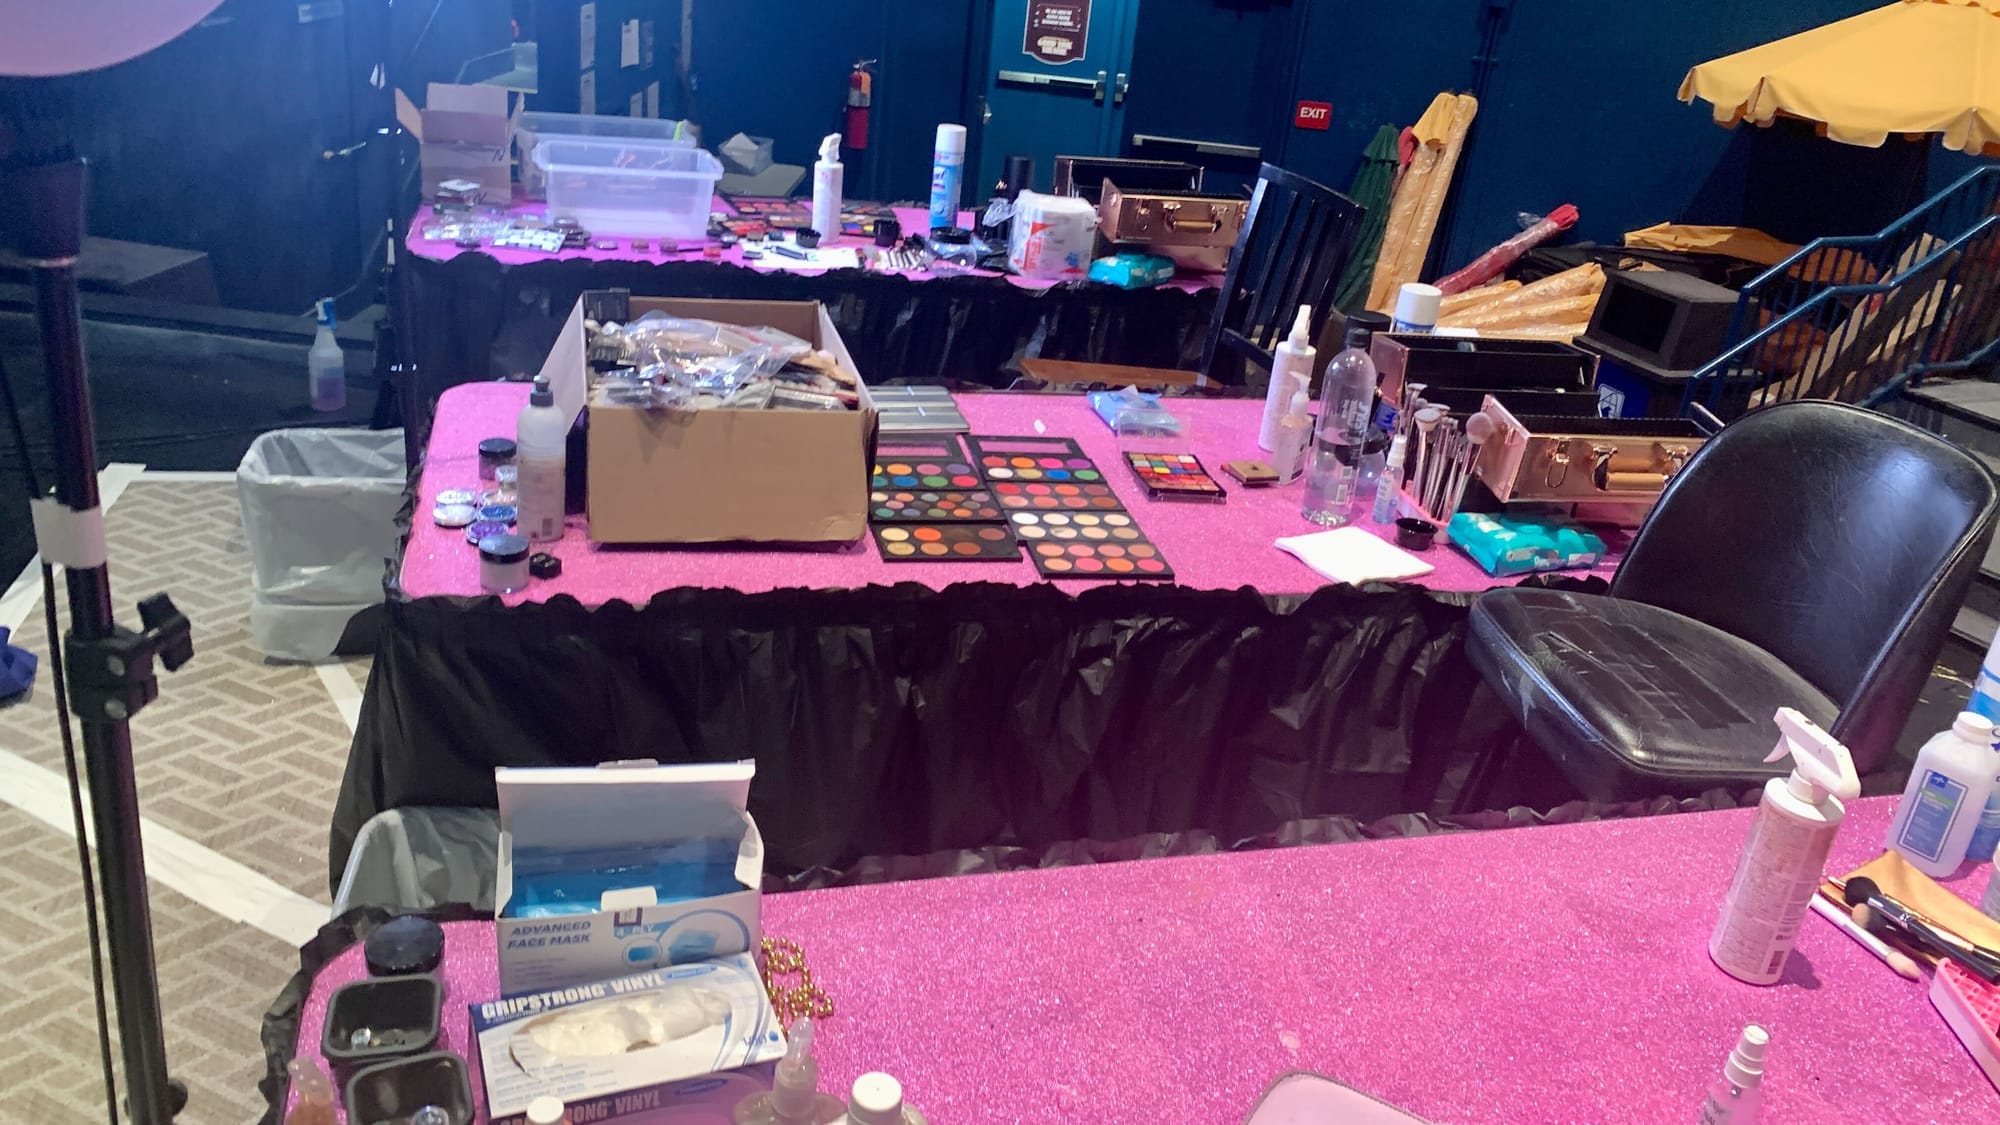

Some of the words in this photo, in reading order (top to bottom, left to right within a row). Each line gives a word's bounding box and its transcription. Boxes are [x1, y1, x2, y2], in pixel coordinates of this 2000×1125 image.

[1300, 106, 1328, 119] EXIT
[511, 920, 591, 937] ADVANCED
[506, 937, 546, 950] FACE
[550, 933, 591, 946] MASK
[481, 983, 605, 1020] GRIPSTRONG
[611, 972, 665, 993] VINYL
[615, 1089, 660, 1115] VINYL
